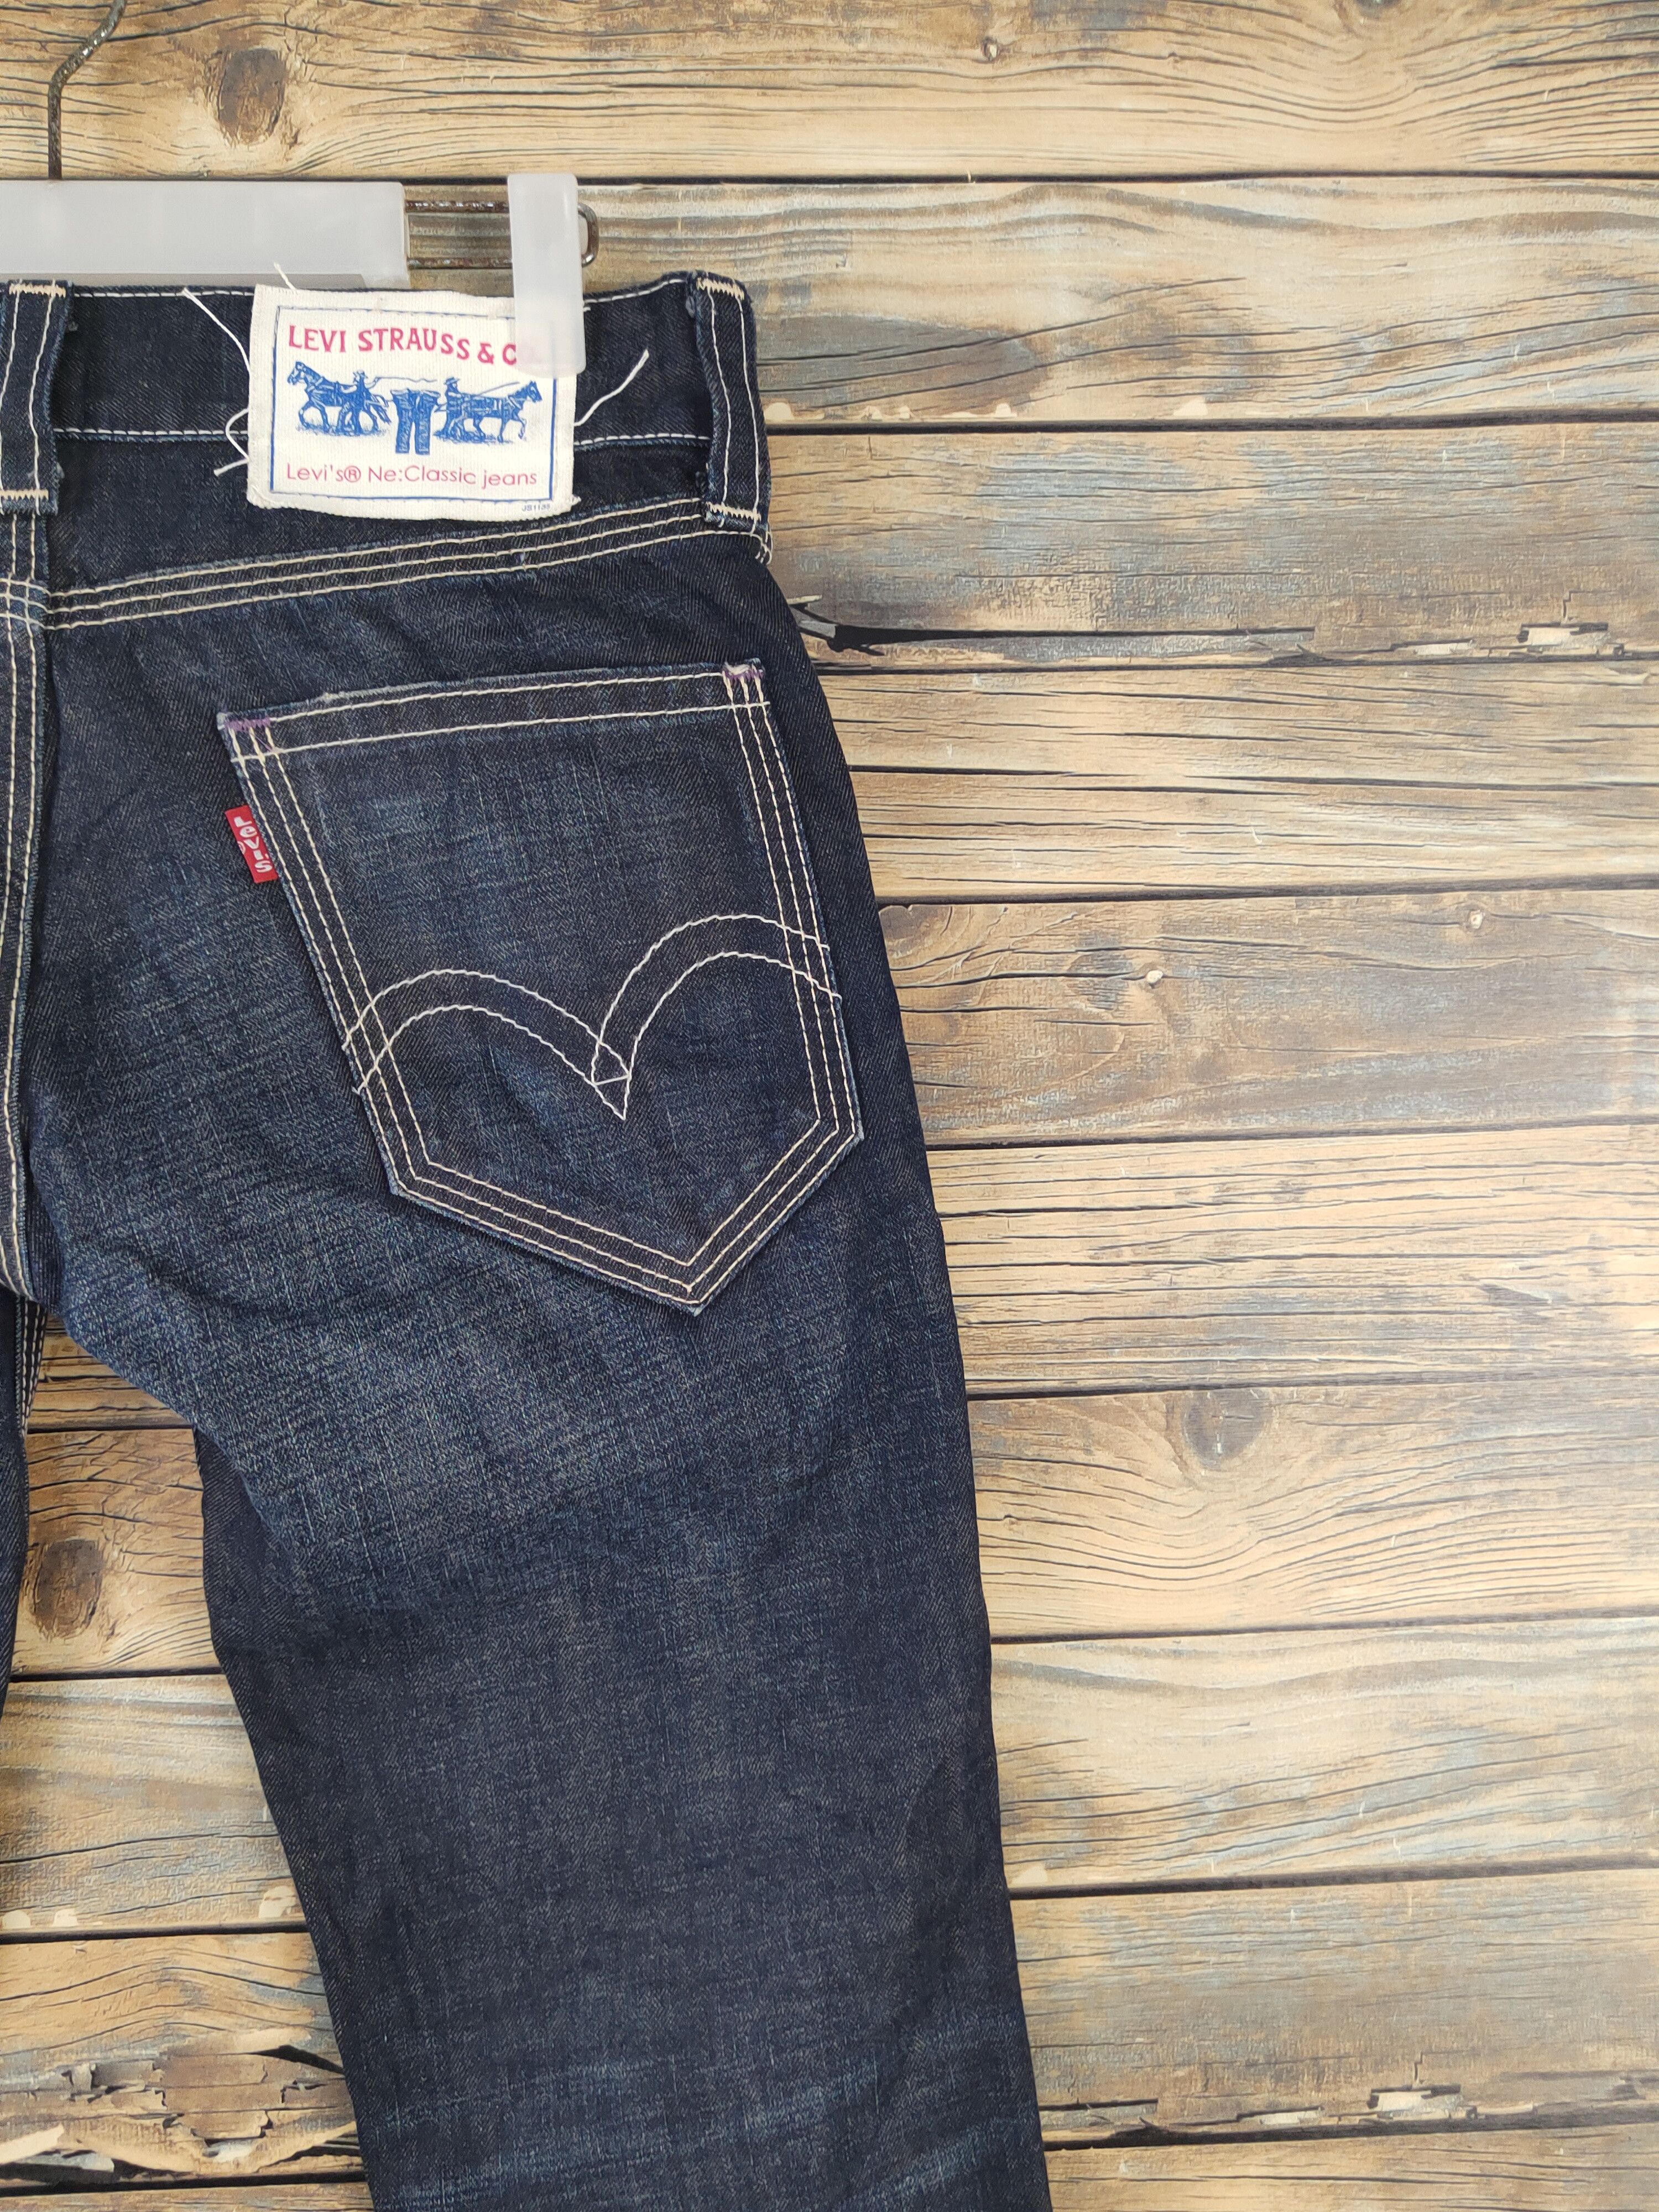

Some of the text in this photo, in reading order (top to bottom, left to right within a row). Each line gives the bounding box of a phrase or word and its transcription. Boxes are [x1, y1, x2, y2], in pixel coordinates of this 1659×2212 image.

[289, 325, 347, 353] LEVI
[358, 327, 471, 361] STRAUSS
[477, 342, 494, 365] &
[481, 469, 537, 490] jeans
